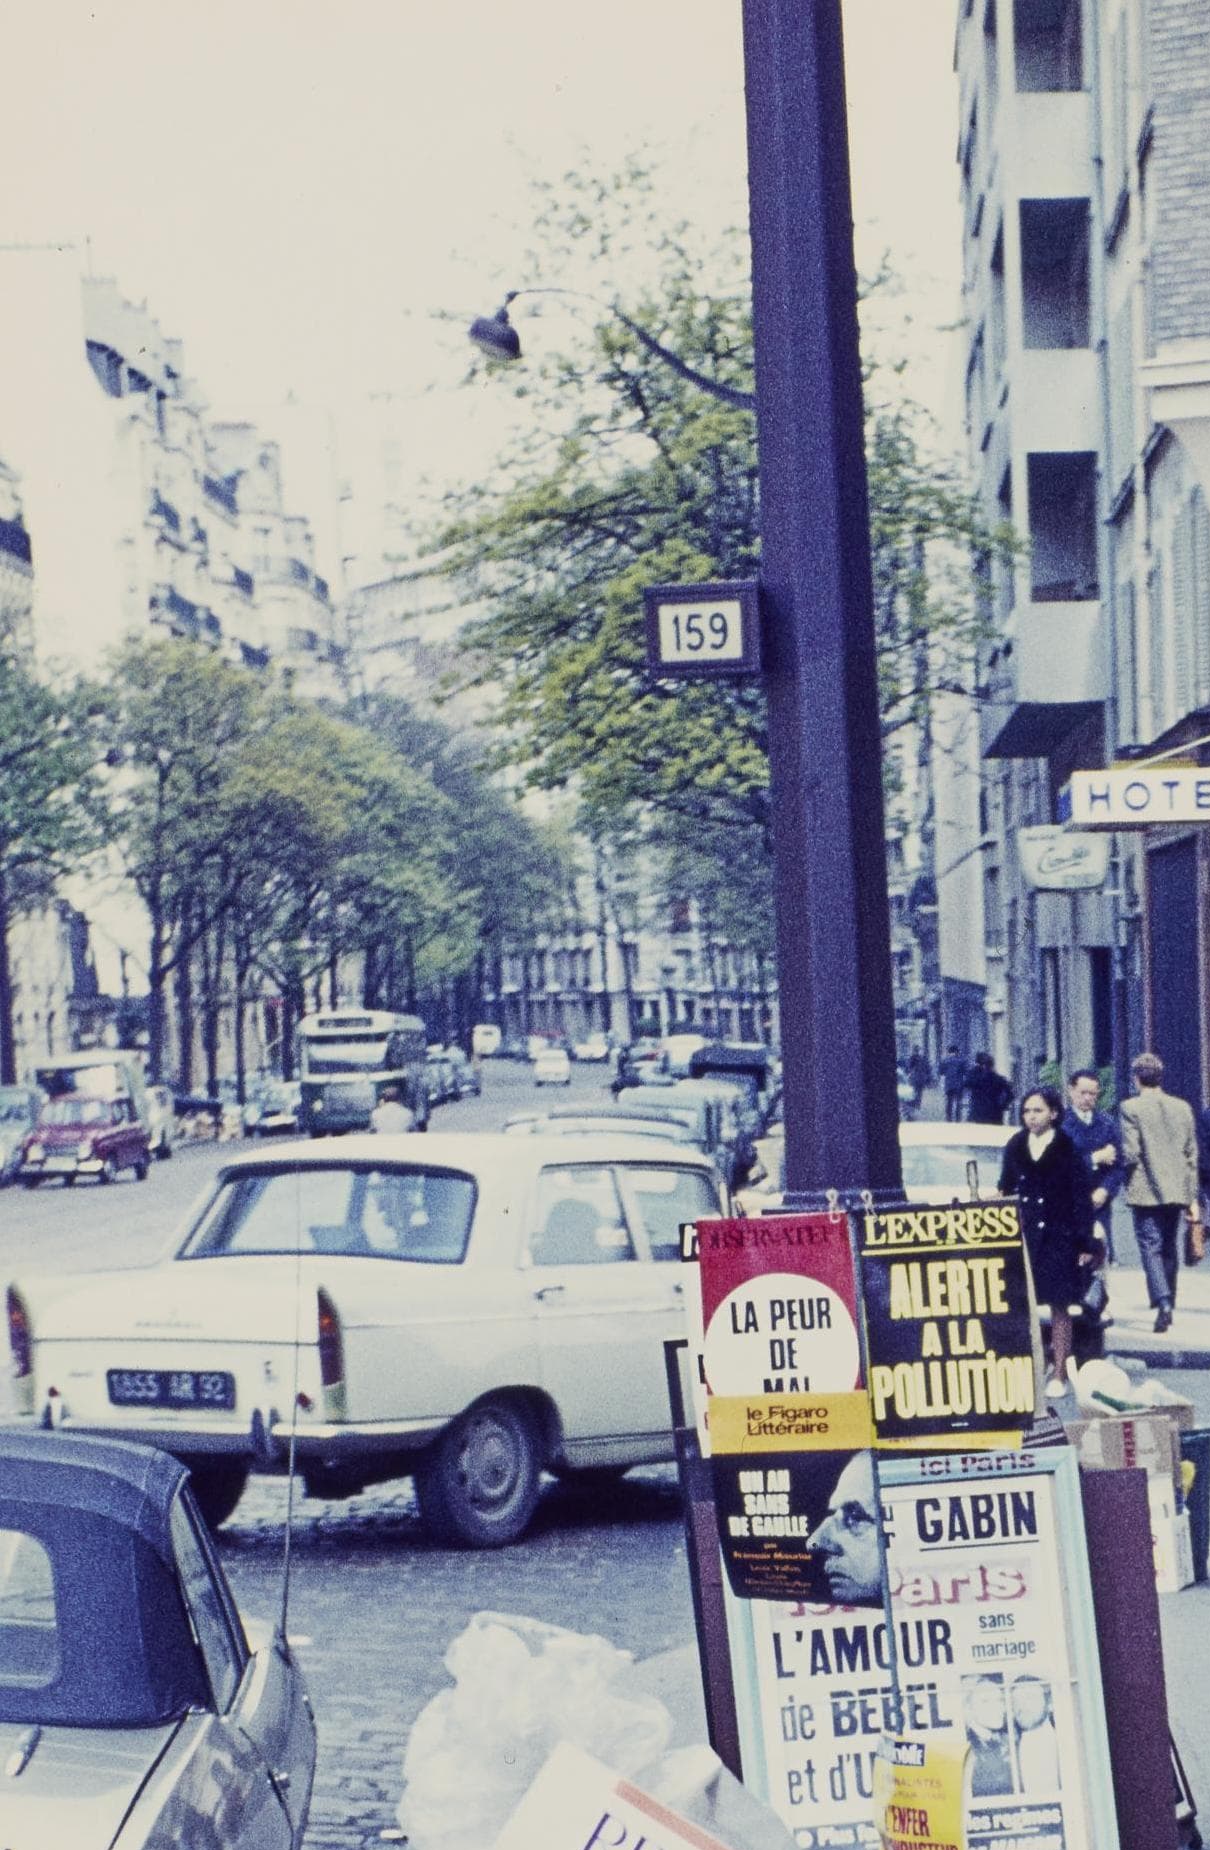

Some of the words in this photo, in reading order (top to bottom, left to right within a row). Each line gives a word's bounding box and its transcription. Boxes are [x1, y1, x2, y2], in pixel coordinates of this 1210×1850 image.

[671, 611, 729, 653] 159
[864, 1206, 1020, 1246] L'EXPRESS
[890, 1257, 1010, 1320] ALERTE
[730, 1300, 760, 1335] LA
[769, 1297, 832, 1332] PEUR
[769, 1337, 798, 1371] DE
[921, 1321, 944, 1358] A
[948, 1318, 986, 1356] LA
[871, 1350, 1035, 1421] POLLUTION
[746, 1406, 763, 1421] le
[768, 1404, 829, 1423] Figaro
[747, 1420, 830, 1436] Littéraire
[960, 1452, 1036, 1474] Paris
[915, 1490, 1038, 1544] GABIN
[772, 1618, 955, 1680] L'AMOUR
[978, 1611, 1016, 1630] sans
[971, 1637, 1037, 1661] mariage
[780, 1695, 817, 1742] de
[787, 1758, 819, 1806] et
